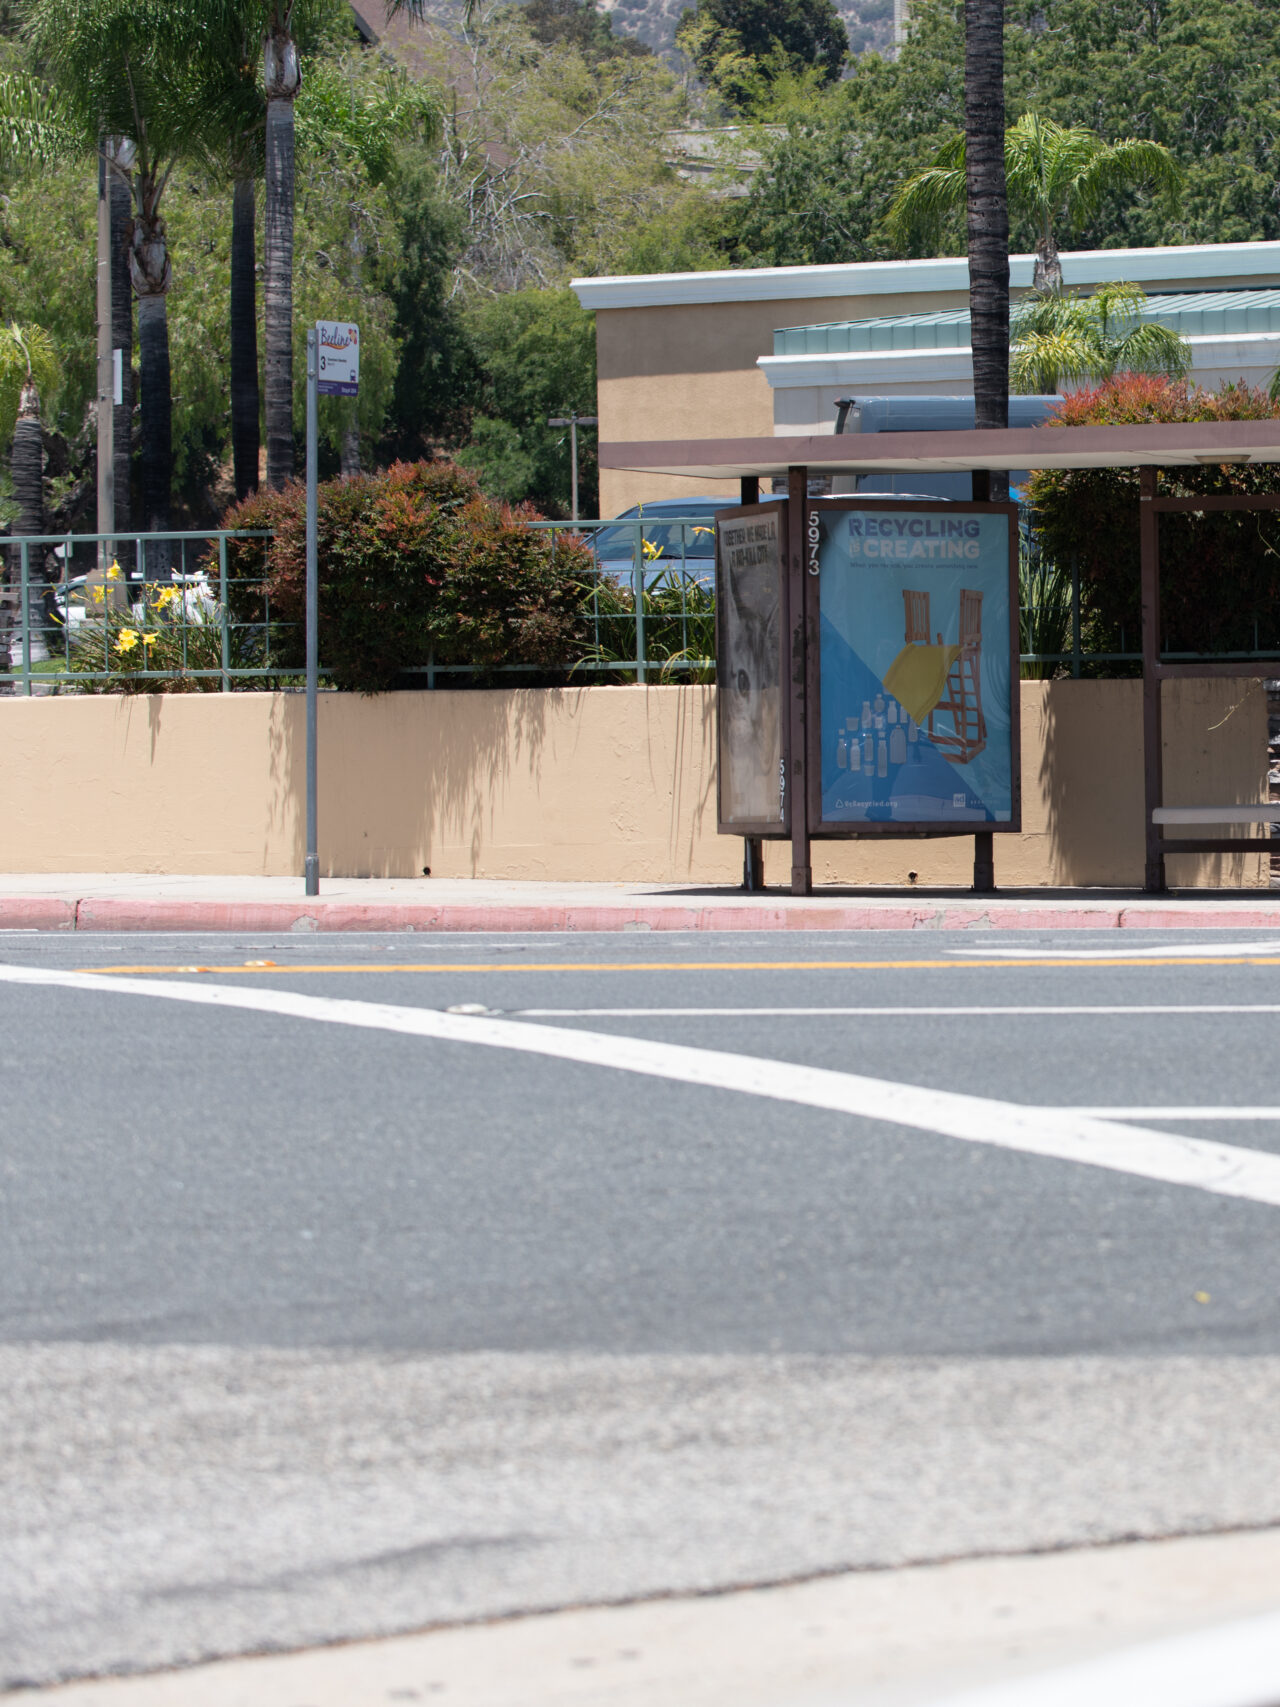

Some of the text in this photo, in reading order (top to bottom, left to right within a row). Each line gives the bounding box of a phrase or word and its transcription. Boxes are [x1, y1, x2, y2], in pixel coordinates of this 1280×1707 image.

[320, 325, 351, 347] Beeline
[320, 356, 326, 370] 3
[848, 518, 980, 537] RECYCLING
[808, 511, 820, 576] 5973
[863, 540, 980, 559] CREATING
